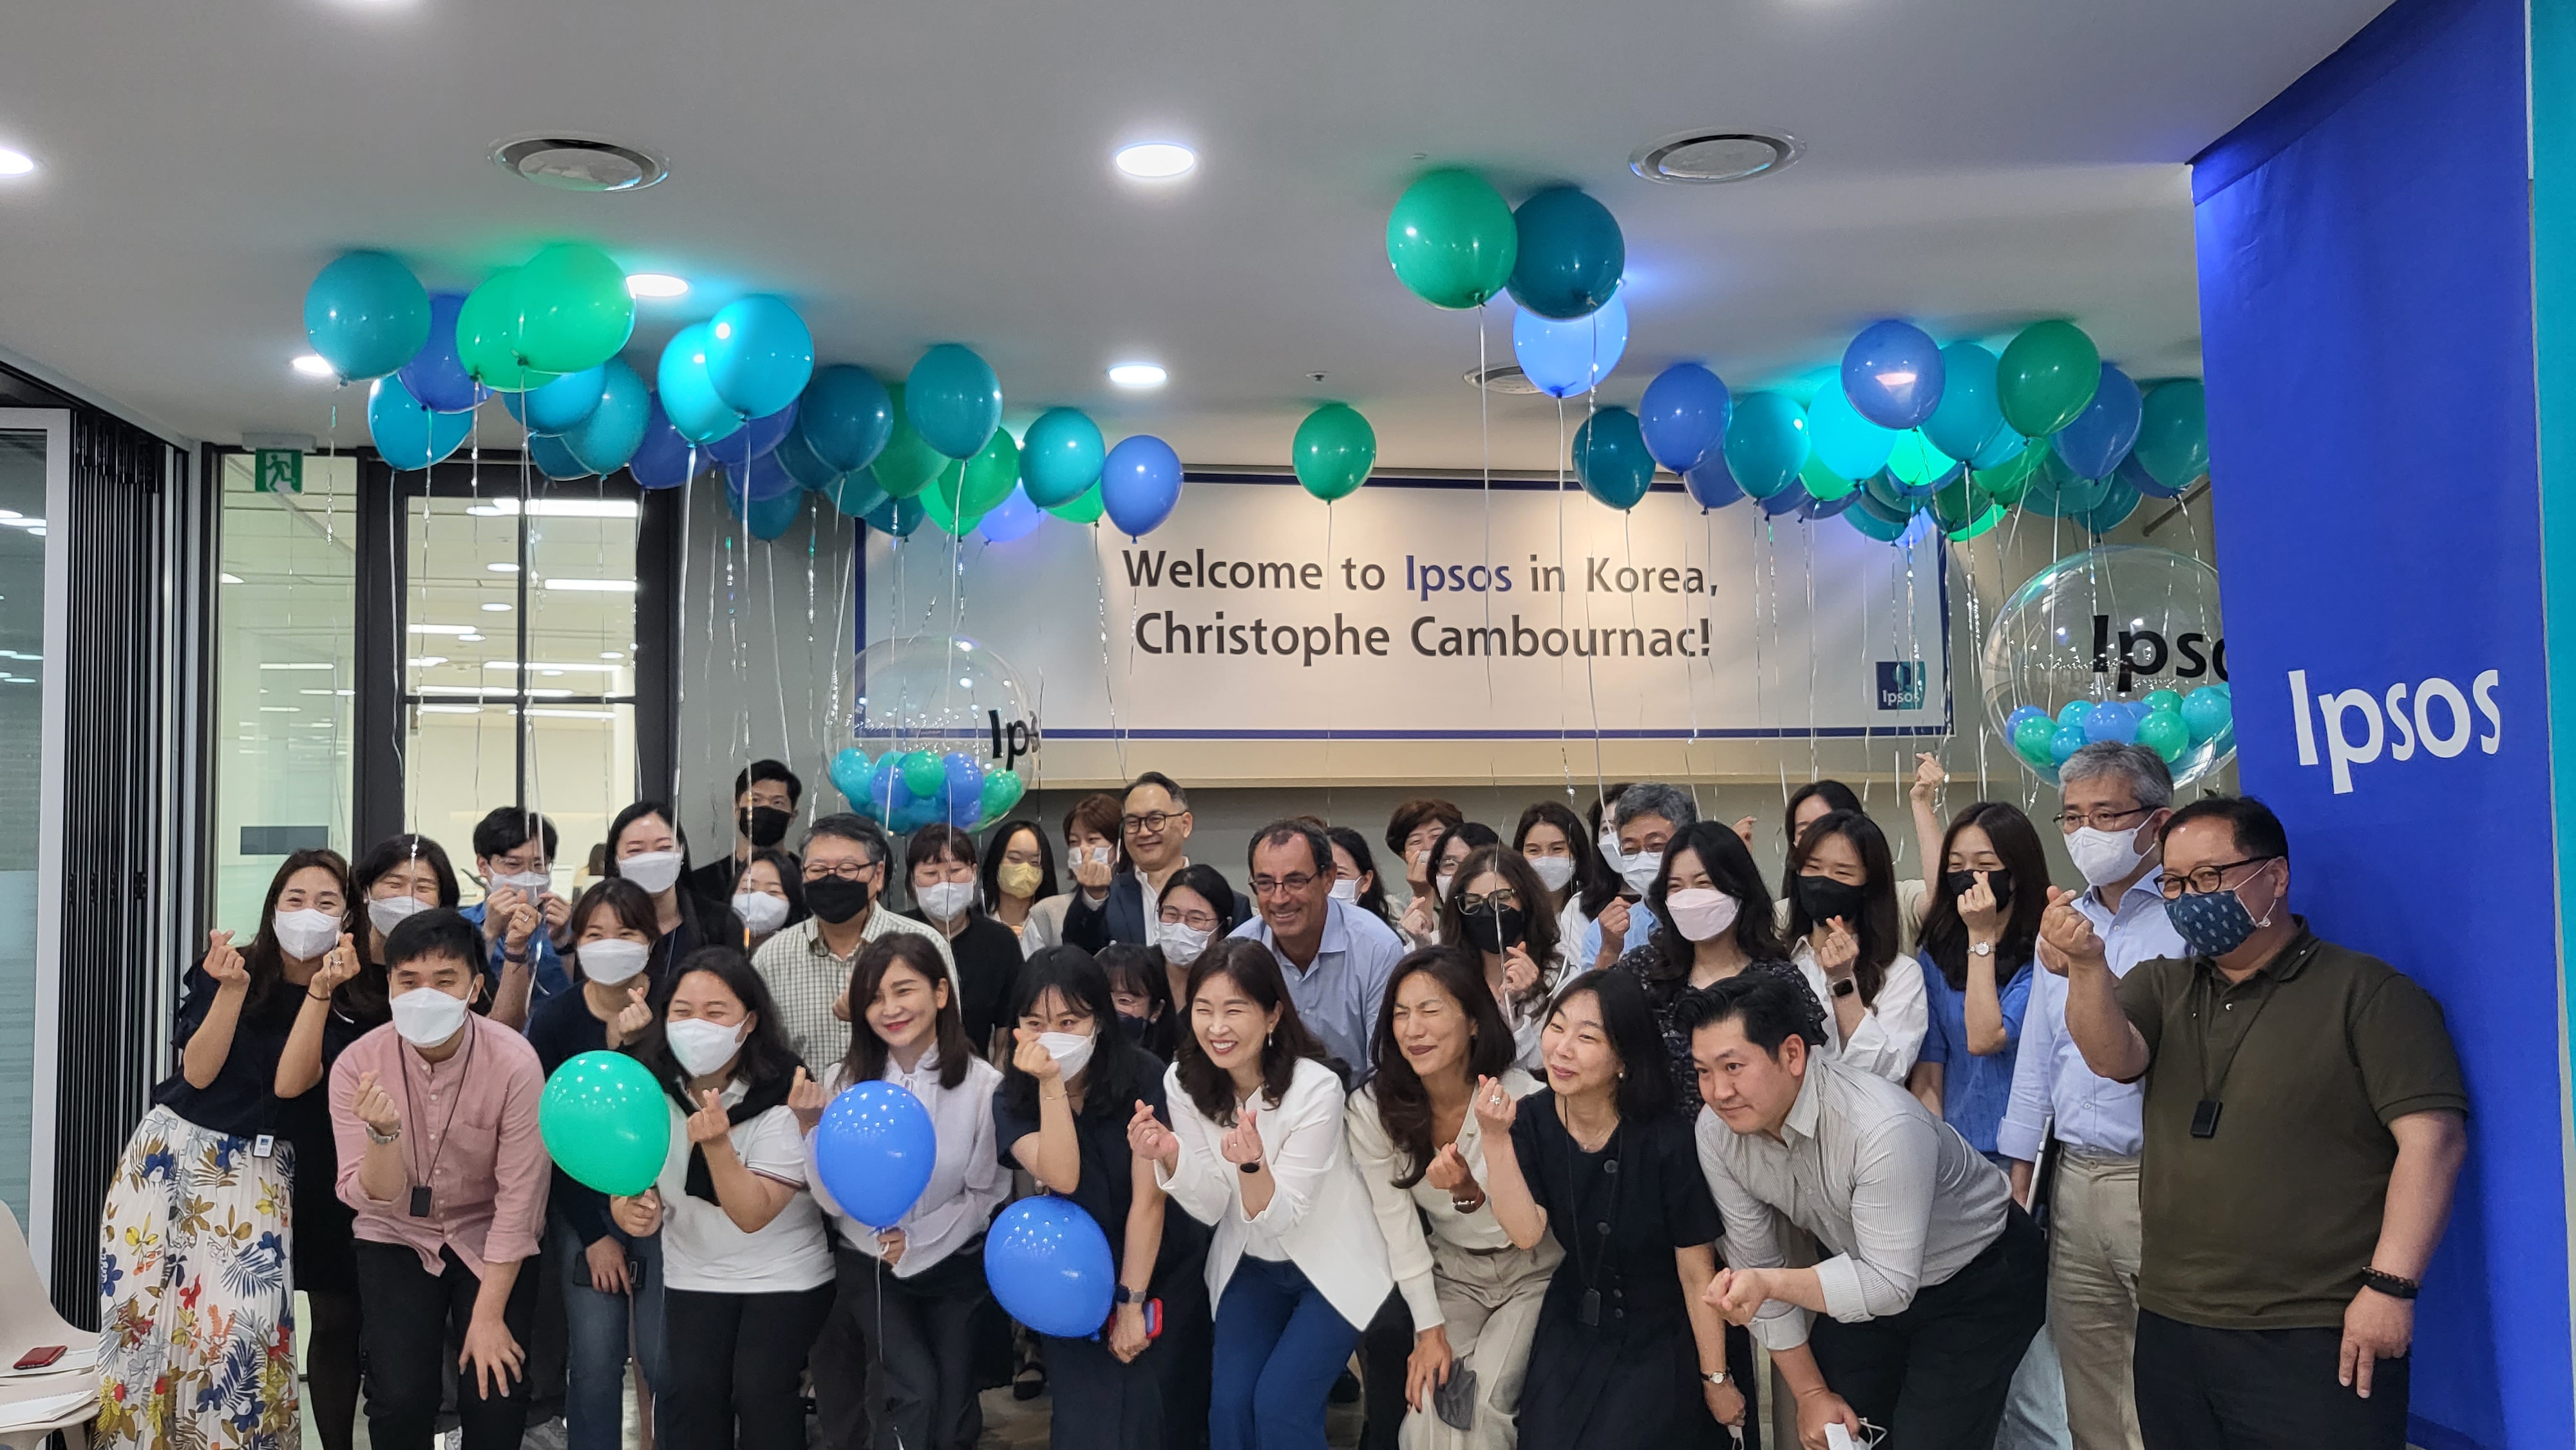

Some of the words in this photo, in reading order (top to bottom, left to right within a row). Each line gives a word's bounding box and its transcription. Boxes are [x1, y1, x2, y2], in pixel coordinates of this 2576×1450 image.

[1121, 548, 1323, 589] Welcome
[1340, 558, 1385, 590] to
[1406, 554, 1513, 602] Ipsos
[1530, 554, 1566, 592] in
[1587, 556, 1718, 597] Korea,
[1135, 610, 1390, 668] Christophe
[1410, 614, 1710, 657] Cambournac!
[1882, 689, 1920, 706] Ipsos
[2287, 668, 2501, 795] Ipsos
